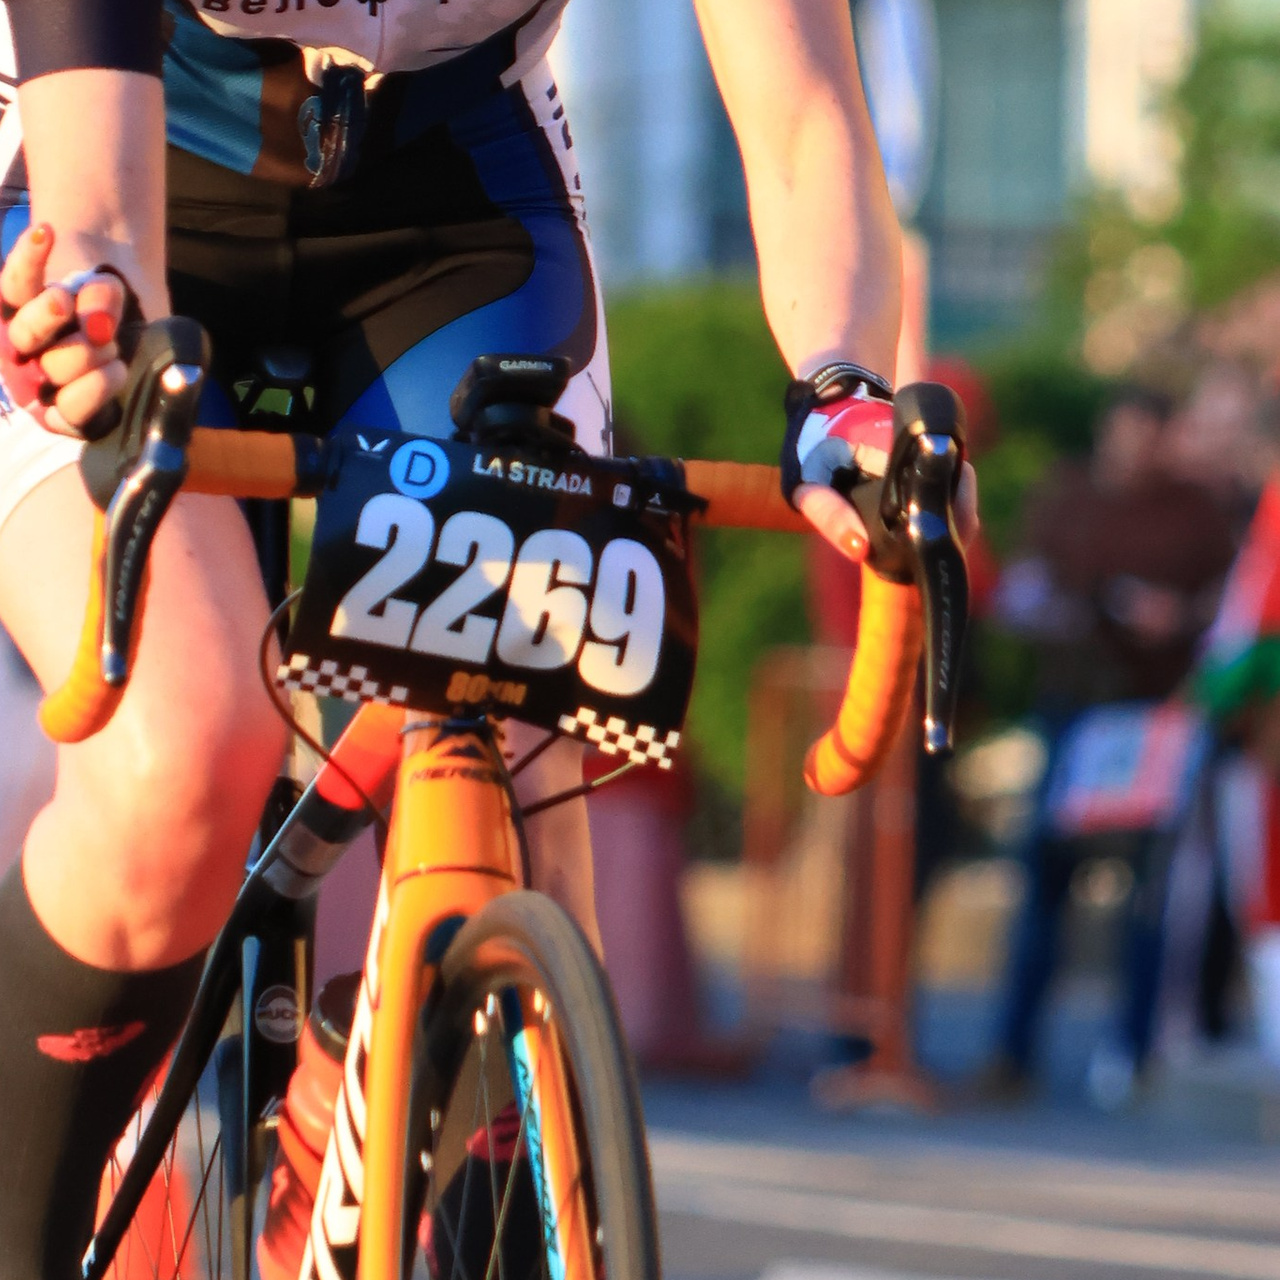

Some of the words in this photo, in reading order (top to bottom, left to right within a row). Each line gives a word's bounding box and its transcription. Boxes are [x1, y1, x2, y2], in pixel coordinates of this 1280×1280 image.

[499, 360, 553, 372] GARMIN
[472, 453, 504, 479] LA
[508, 461, 592, 497] STRADA
[329, 493, 666, 697] 2269
